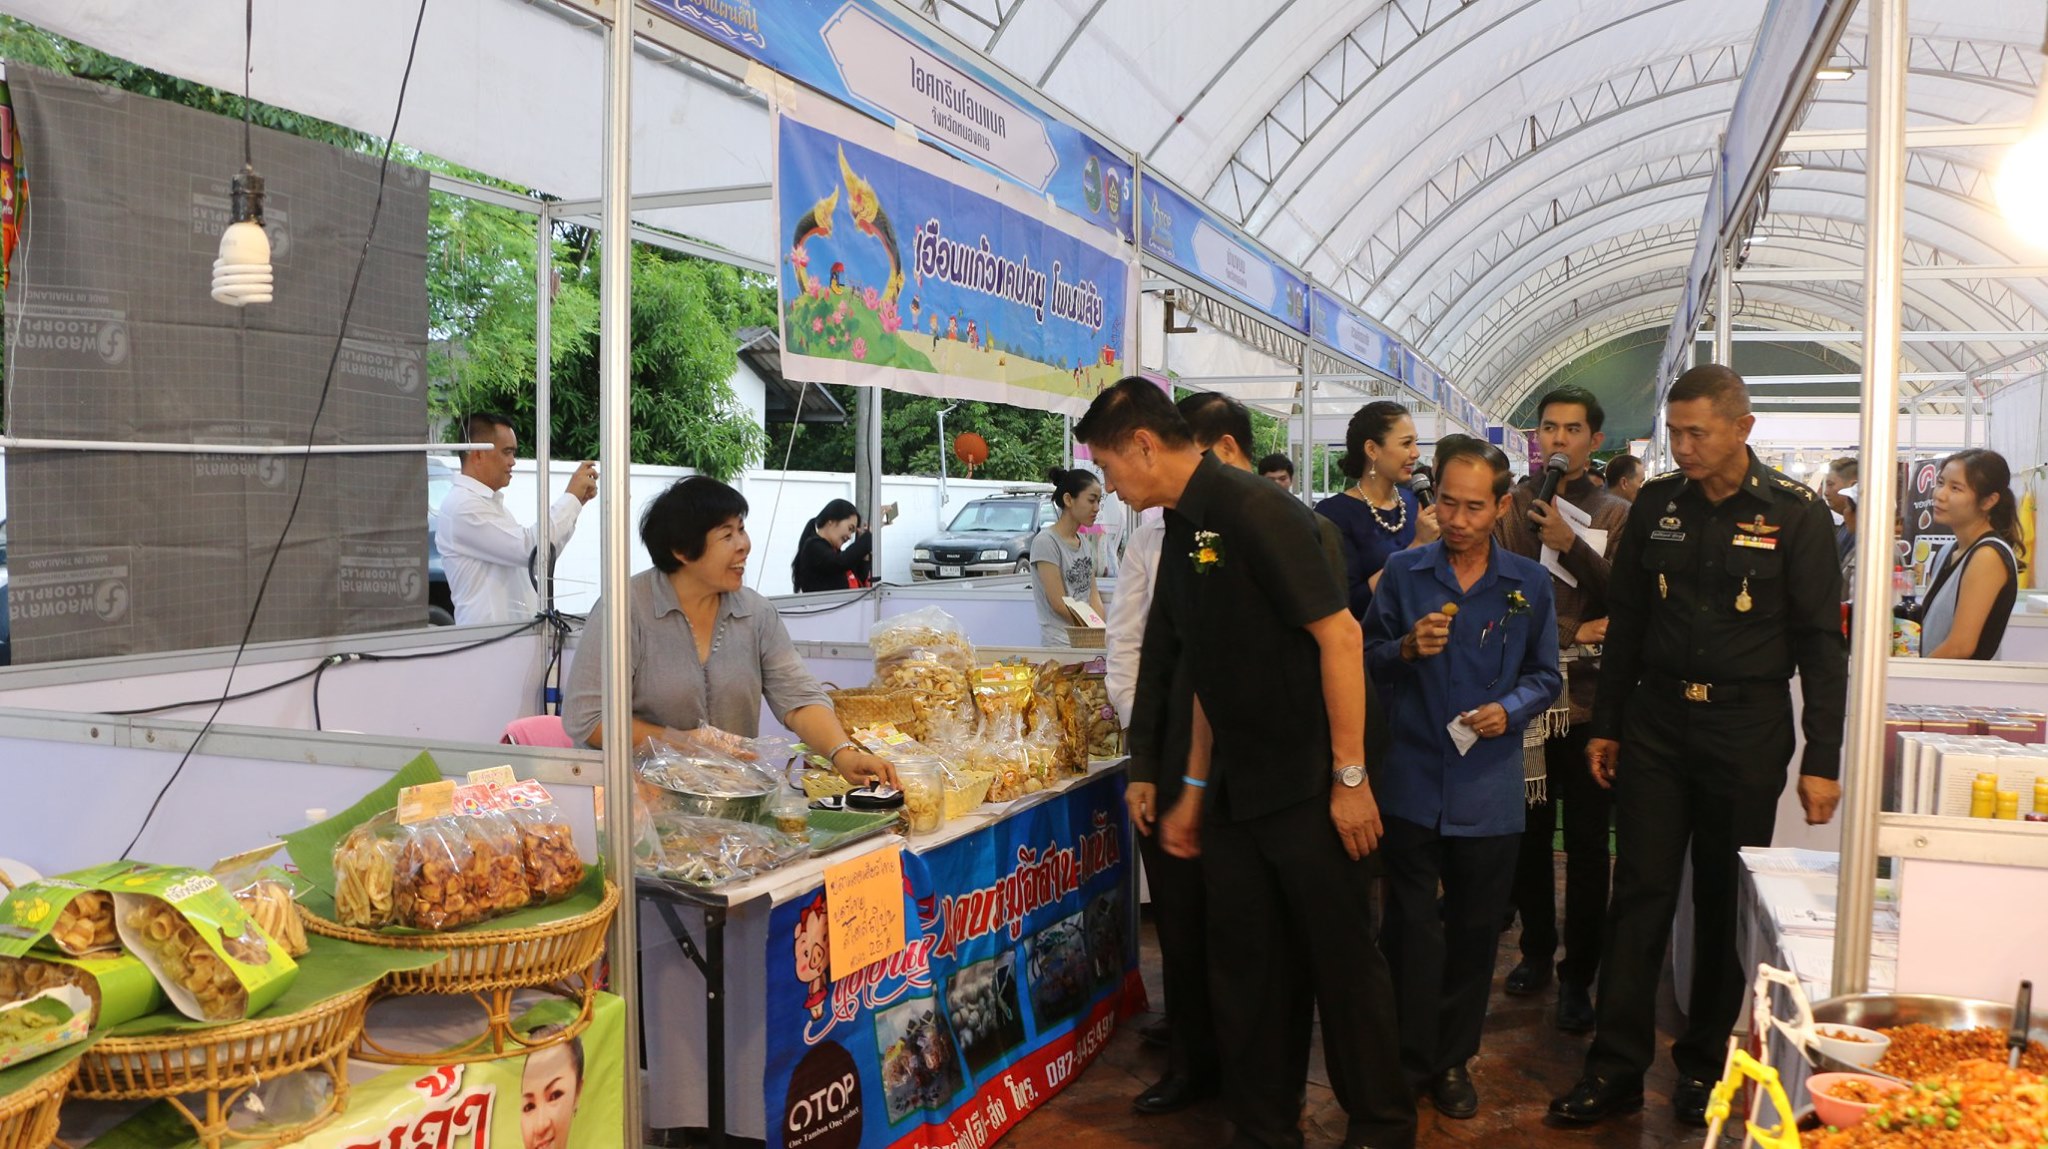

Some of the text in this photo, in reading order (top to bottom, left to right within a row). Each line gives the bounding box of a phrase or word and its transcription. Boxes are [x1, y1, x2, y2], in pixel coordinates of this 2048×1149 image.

[931, 105, 990, 152] จังหวัดหนองคาย
[1051, 260, 1103, 330] โพนพิสัย
[789, 1073, 855, 1132] OTOP
